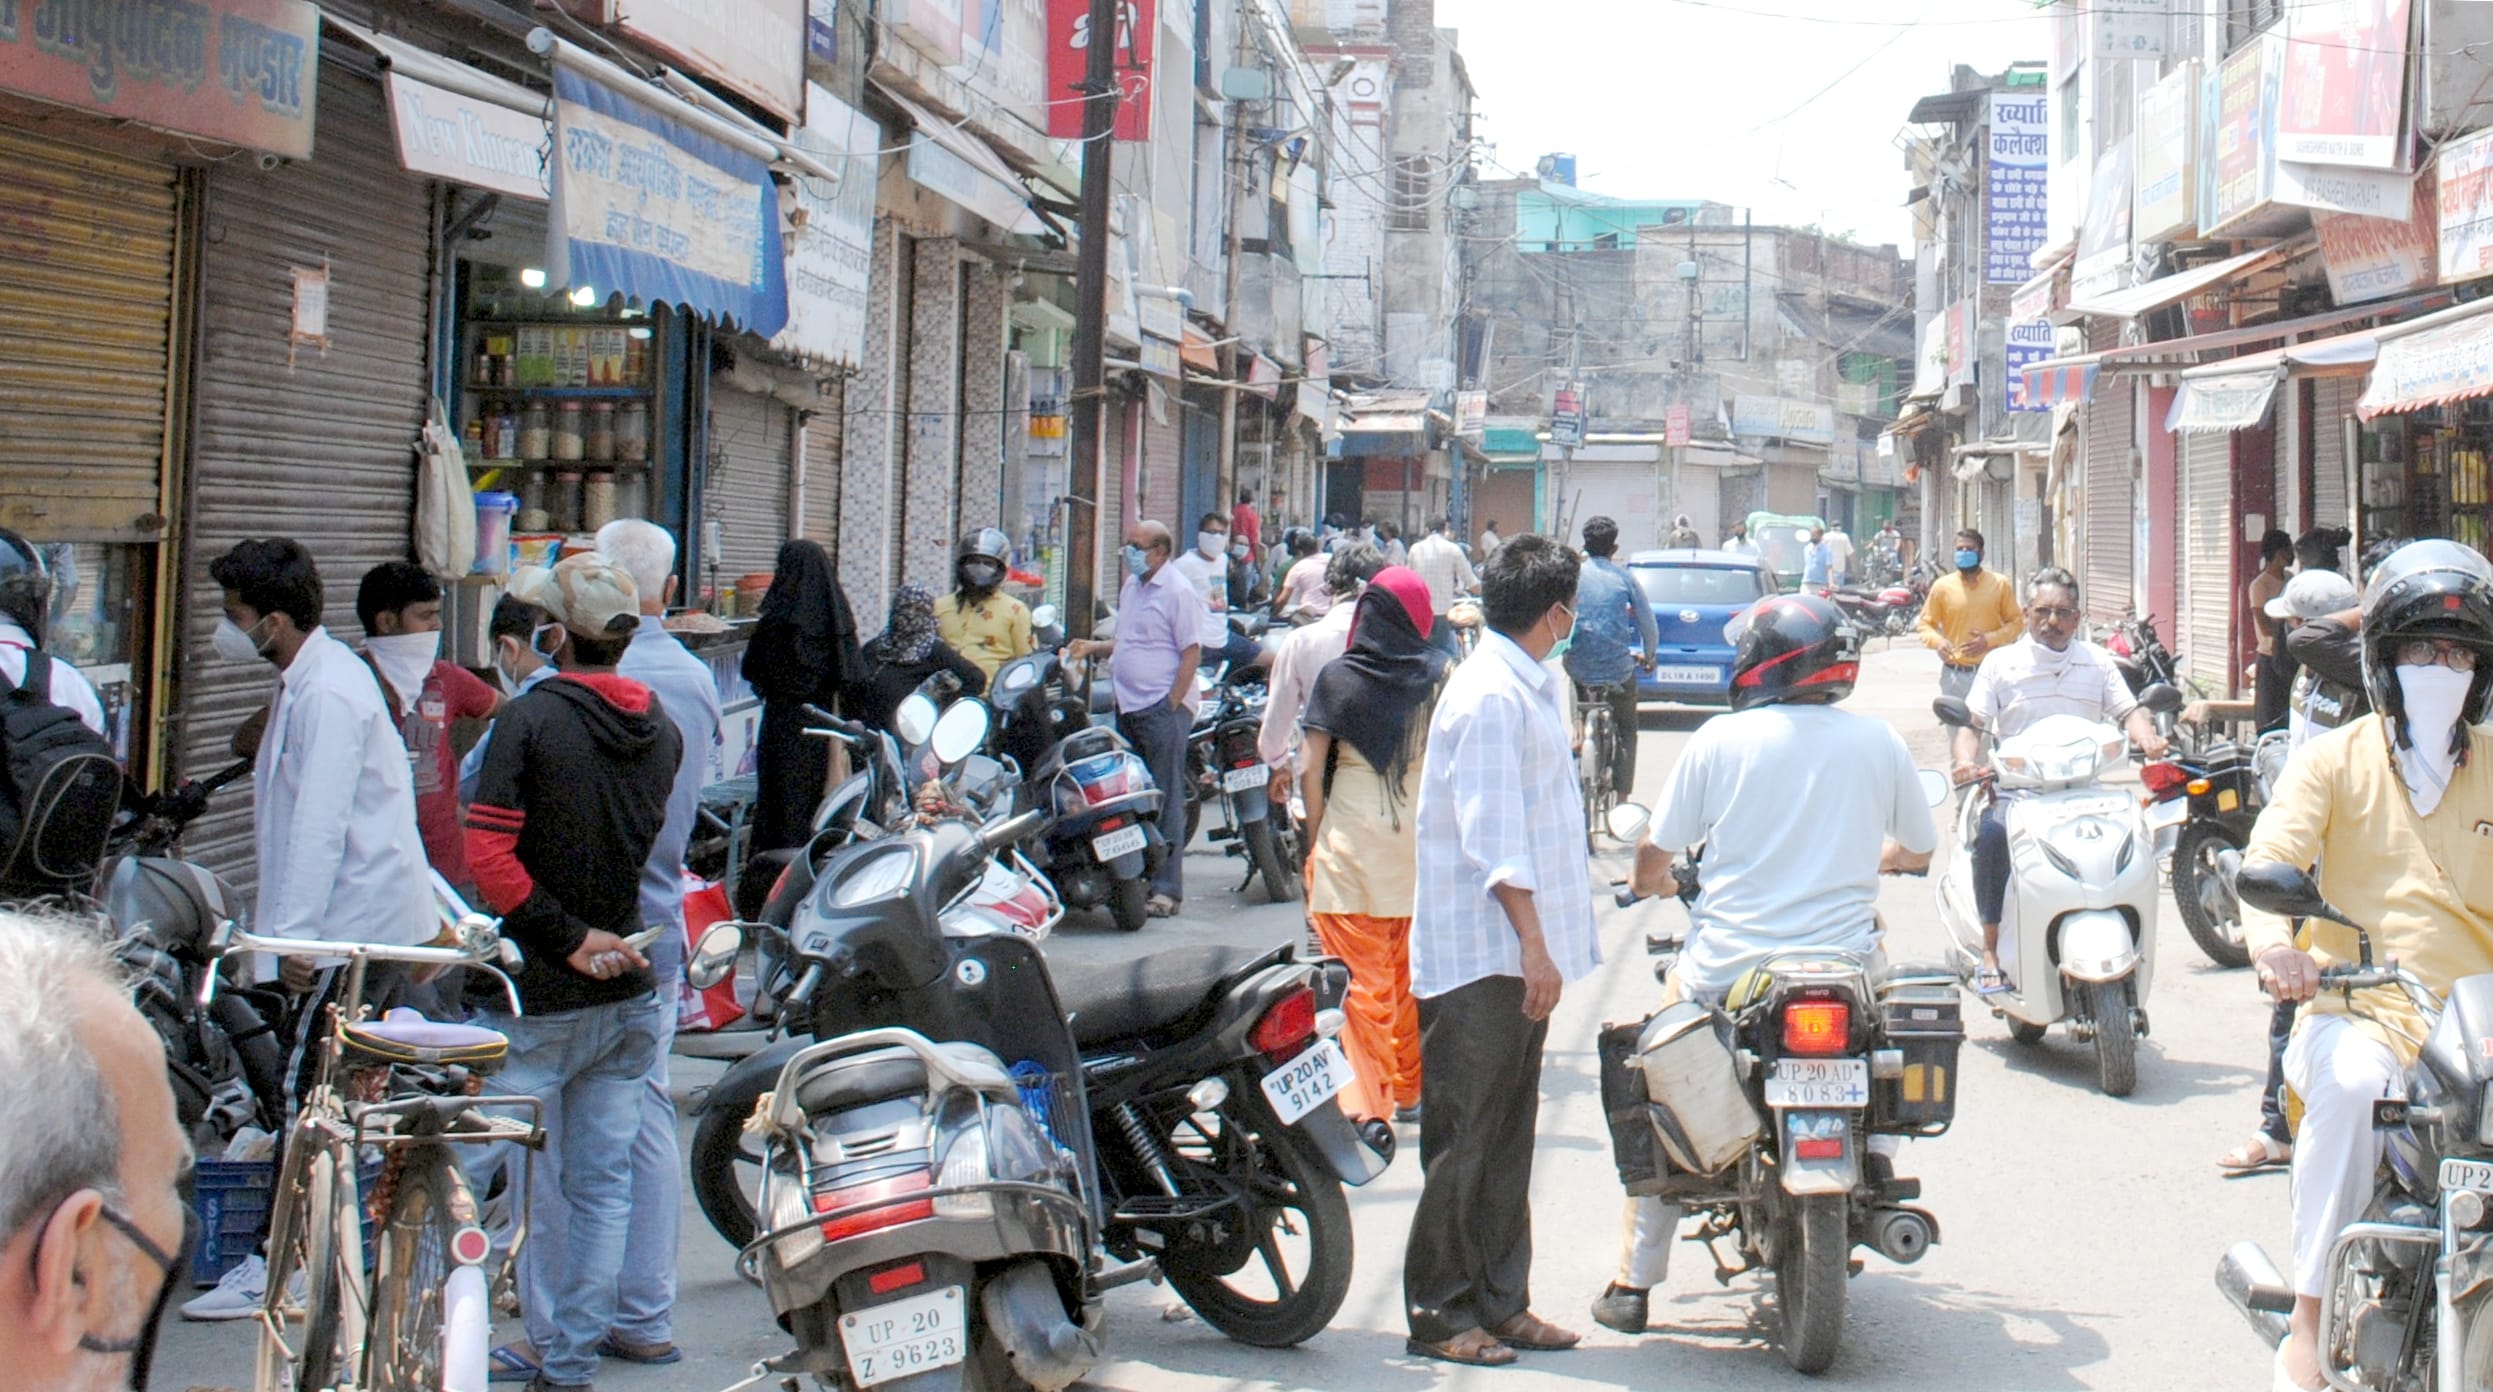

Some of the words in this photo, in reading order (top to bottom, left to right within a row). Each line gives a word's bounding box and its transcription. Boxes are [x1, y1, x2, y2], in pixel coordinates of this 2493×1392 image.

[402, 89, 457, 158] New
[1778, 1063, 1802, 1081] UP
[1807, 1063, 1826, 1081] 20
[1832, 1064, 1853, 1081] AD
[1291, 1073, 1334, 1112] 9142
[1787, 1085, 1846, 1103] 8083
[2447, 1165, 2474, 1187] UP
[867, 1319, 895, 1344] UP
[912, 1308, 940, 1333] 20
[862, 1357, 875, 1380] Z
[892, 1336, 956, 1370] 9623
